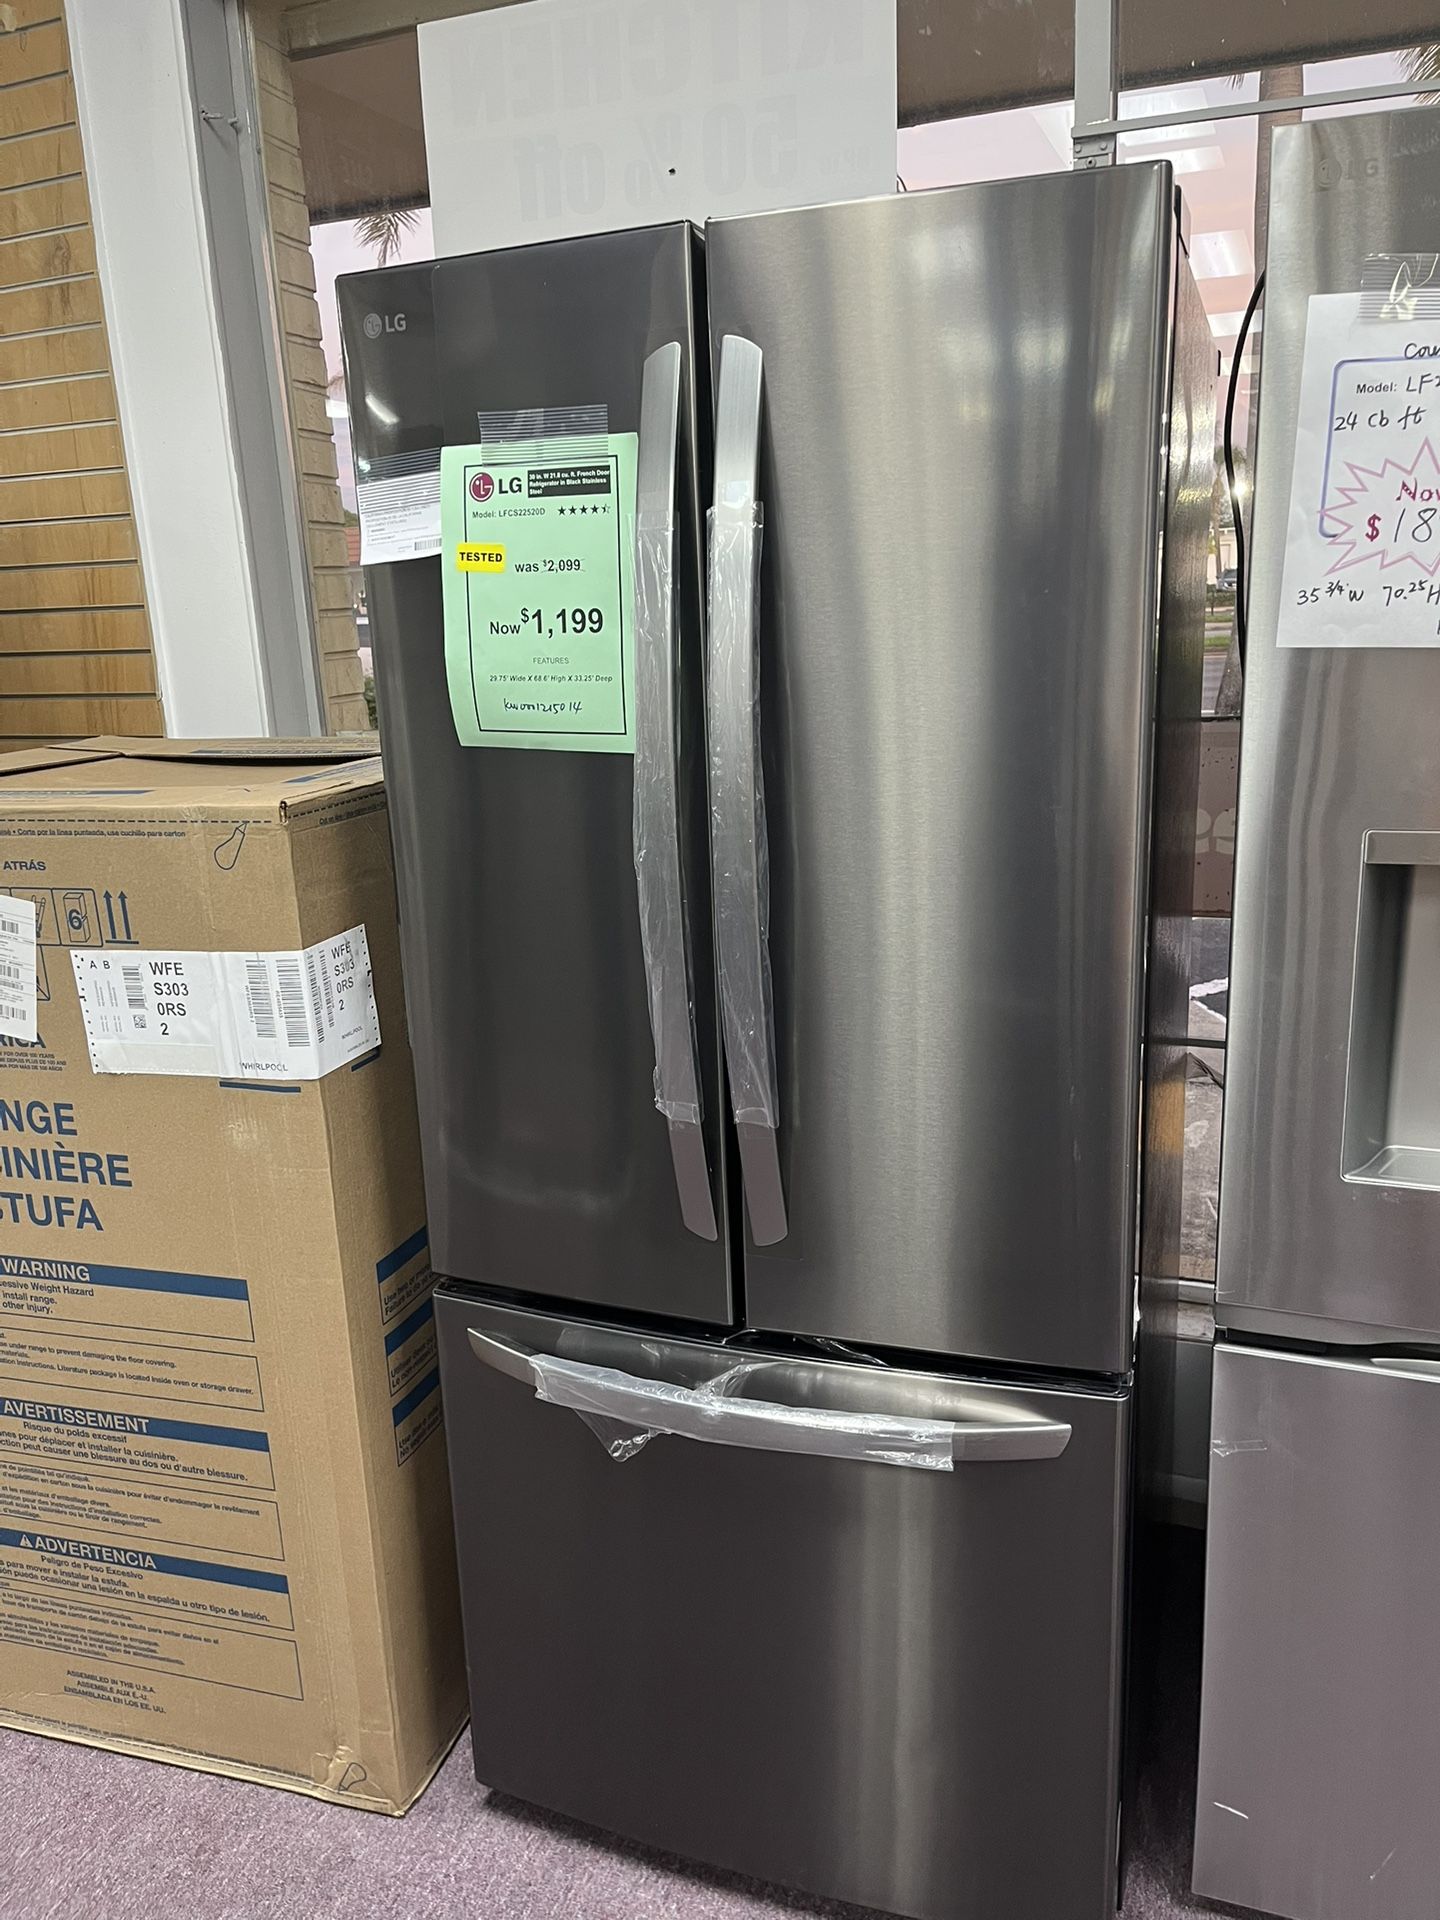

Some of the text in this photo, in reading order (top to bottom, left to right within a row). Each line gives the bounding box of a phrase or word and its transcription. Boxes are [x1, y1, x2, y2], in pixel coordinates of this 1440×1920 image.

[385, 313, 406, 332] LG
[1356, 382, 1397, 394] Model:
[1334, 405, 1426, 431] 24 Cb ft
[499, 477, 522, 494] LG
[499, 508, 545, 517] LFCS22520D
[459, 552, 502, 562] TESTED
[515, 559, 581, 573] was $2,099
[490, 608, 603, 638] Now $1,199
[551, 675, 566, 683] High
[3, 860, 46, 871] ATRÁS
[68, 909, 82, 930] 6
[331, 941, 351, 959] WFE
[90, 961, 110, 969] A B
[149, 962, 184, 976] WFE
[154, 982, 189, 996] S303
[339, 1000, 344, 1011] 2
[160, 1023, 169, 1035] 2
[241, 1062, 288, 1071] WHIRLPOOL
[0, 1141, 132, 1187] INIÈRE
[0, 1192, 104, 1231] TUFA
[1, 1258, 90, 1281] WARNING
[30, 1282, 61, 1293] Weight
[63, 1285, 94, 1296] Hazard
[2, 1291, 57, 1305] install range.
[3, 1301, 53, 1314] other injury.
[28, 1345, 47, 1353] range
[56, 1348, 81, 1356] prevent
[82, 1351, 115, 1361] damaging
[4, 1400, 149, 1433] AVERTISSEMENT
[24, 1421, 127, 1443] Risque du poids excessif
[19, 1432, 177, 1463] pour déplacer et installer la cuisinière.
[23, 1441, 42, 1451] peut
[43, 1445, 71, 1455] causer
[73, 1450, 89, 1458] une
[91, 1451, 127, 1463] blessure
[142, 1459, 158, 1468] dos
[161, 1462, 171, 1470] ou
[175, 1463, 204, 1474] d'autre
[207, 1467, 248, 1480] blessure.
[35, 1535, 156, 1569] ADVERTENCIA
[7, 1561, 24, 1569] para
[26, 1564, 50, 1574] mover
[60, 1570, 90, 1580] instalar
[101, 1578, 129, 1588] estufa.
[41, 1555, 69, 1567] Peligro
[84, 1563, 104, 1573] Peso
[106, 1567, 143, 1579] Excesivo
[14, 1570, 39, 1579] puede
[41, 1575, 80, 1587] ocasionar
[82, 1582, 97, 1591] una
[99, 1584, 124, 1596] lesión
[125, 1590, 136, 1598] en
[137, 1591, 145, 1599] la
[147, 1595, 180, 1606] espalda
[190, 1601, 207, 1610] otro
[209, 1604, 226, 1614] tipo
[228, 1608, 239, 1616] de
[241, 1610, 270, 1622] lesión.
